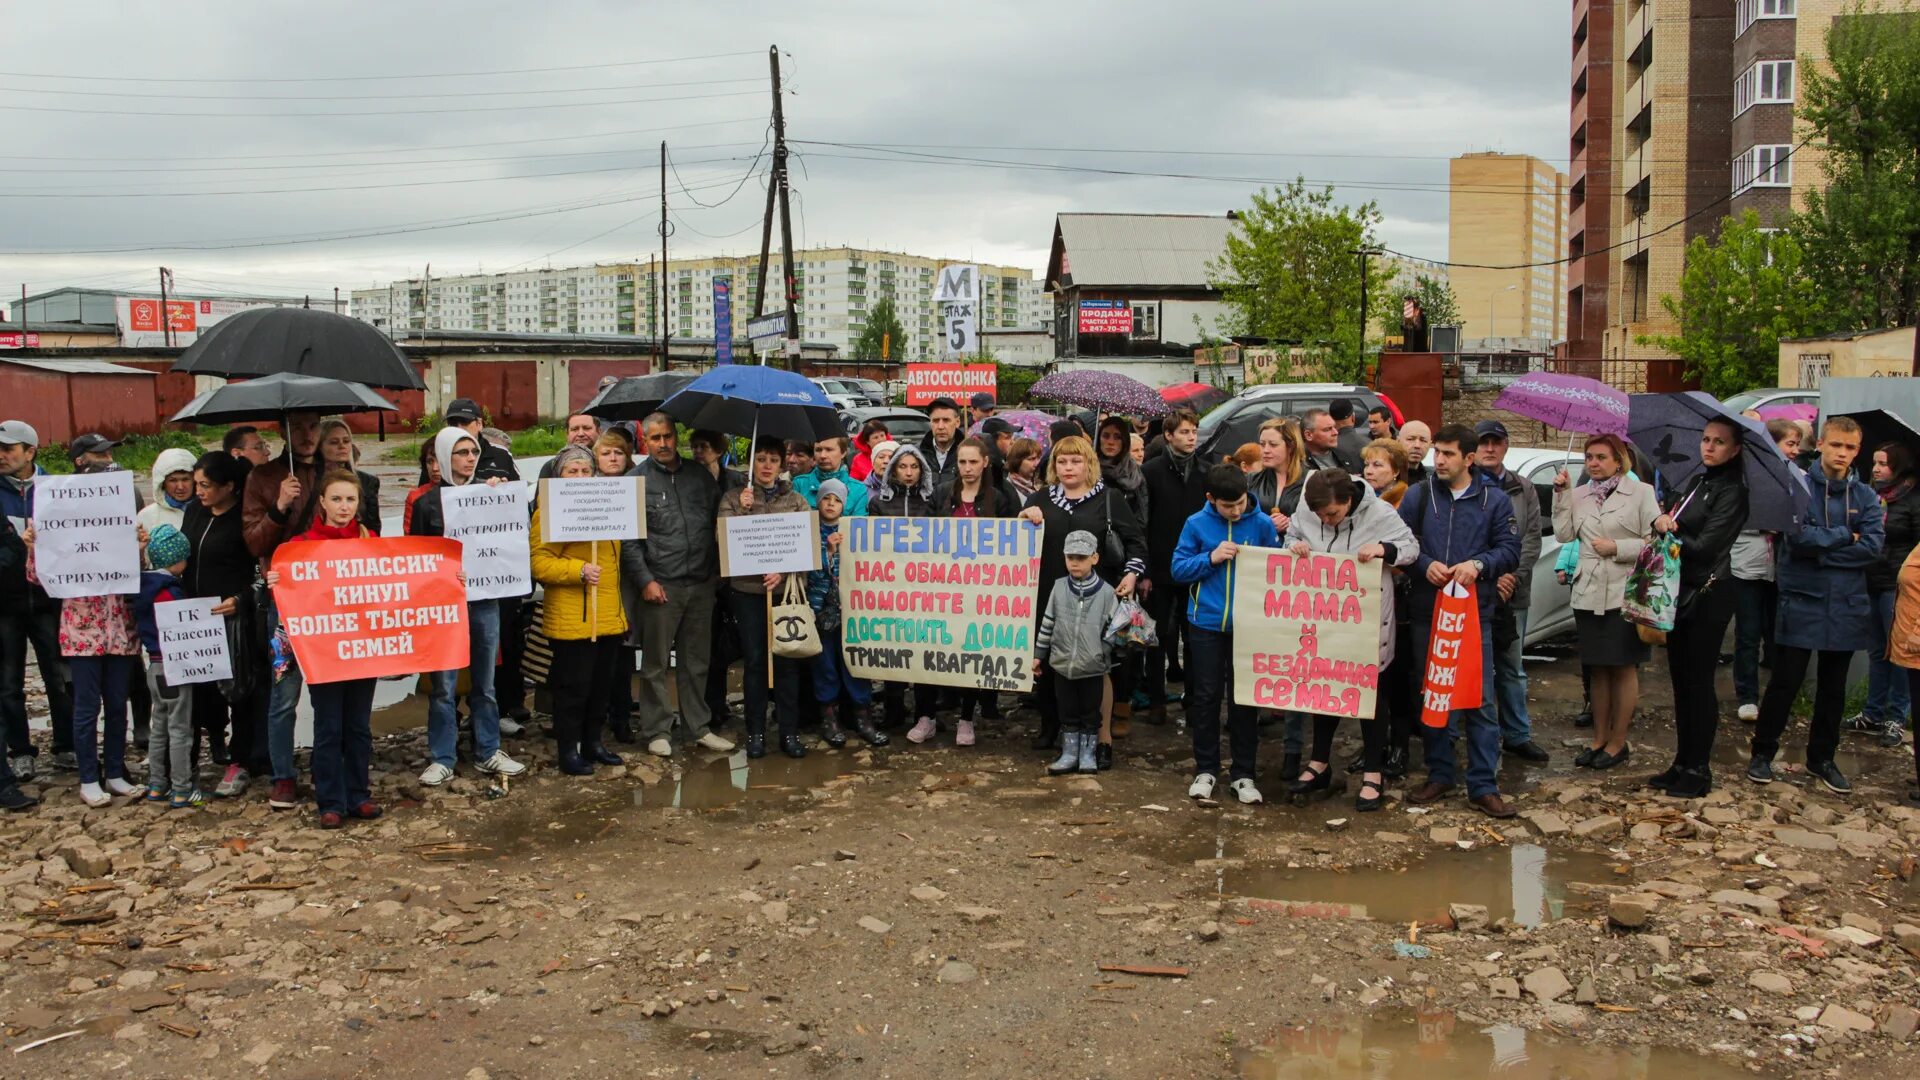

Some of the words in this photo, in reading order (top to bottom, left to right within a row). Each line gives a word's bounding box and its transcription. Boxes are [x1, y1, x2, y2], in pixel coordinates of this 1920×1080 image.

[941, 267, 972, 298] М
[944, 304, 972, 317] ЭТАЖ
[1081, 310, 1130, 318] ПРОДАЖА
[950, 320, 966, 350] 5
[907, 370, 997, 387] АВТОСТОЯНКА
[51, 485, 120, 499] ТРЕБУЕМ
[456, 494, 515, 507] ТРЕБУЕМ
[38, 516, 133, 532] ДОСТРОИТЬ
[449, 522, 523, 538] ДОСТРОИТЬ
[75, 542, 101, 553] ЖК
[850, 518, 1042, 560] ПРЕЗИДЕНТ
[476, 547, 498, 558] ЖК
[291, 561, 320, 581] СК
[326, 554, 444, 579] "КЛАССИК"
[855, 561, 896, 582] НАС
[1266, 554, 1367, 598] ПАПА,
[48, 572, 130, 586] «ТРИУМФ»
[468, 575, 522, 587] РИУМФ»
[334, 582, 409, 606] КИНУЛ
[850, 590, 964, 614] ПОМОГИТЕ
[976, 594, 1031, 617] НАМ
[1264, 589, 1362, 624] МАМА
[178, 608, 200, 622] ГК
[287, 613, 358, 636] БОЛЕЕ
[366, 604, 459, 630] ТЫСЯЧИ
[163, 627, 223, 642] Классик
[845, 616, 953, 645] ДОСТРОИТЬ
[961, 622, 1029, 652] ДОМА
[168, 650, 190, 662] где
[194, 644, 222, 660] мой
[338, 632, 413, 659] СЕМЕЙ
[182, 664, 214, 678] дом?
[923, 650, 1008, 676] КВАРТАЛ
[1011, 657, 1027, 680] 2
